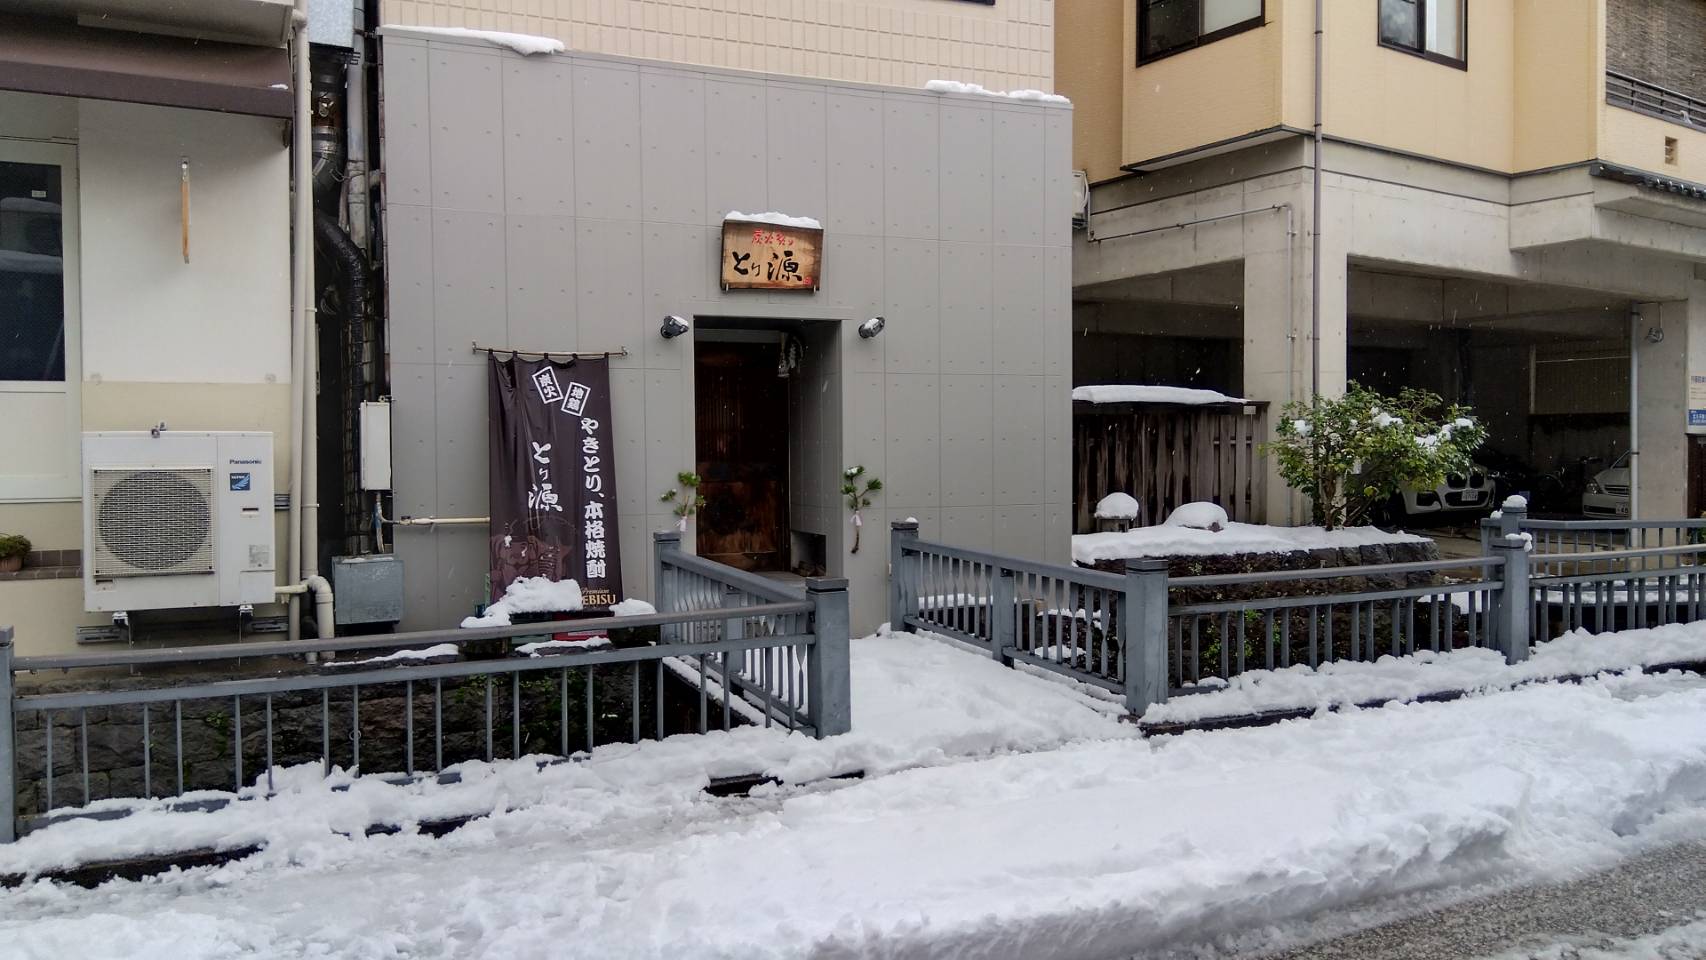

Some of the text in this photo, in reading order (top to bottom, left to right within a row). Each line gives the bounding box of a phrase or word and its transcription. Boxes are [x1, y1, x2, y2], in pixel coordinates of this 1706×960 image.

[732, 250, 803, 281] とり源
[538, 373, 558, 398] 炭火
[528, 441, 563, 512] とり源
[582, 594, 616, 605] EBISU
